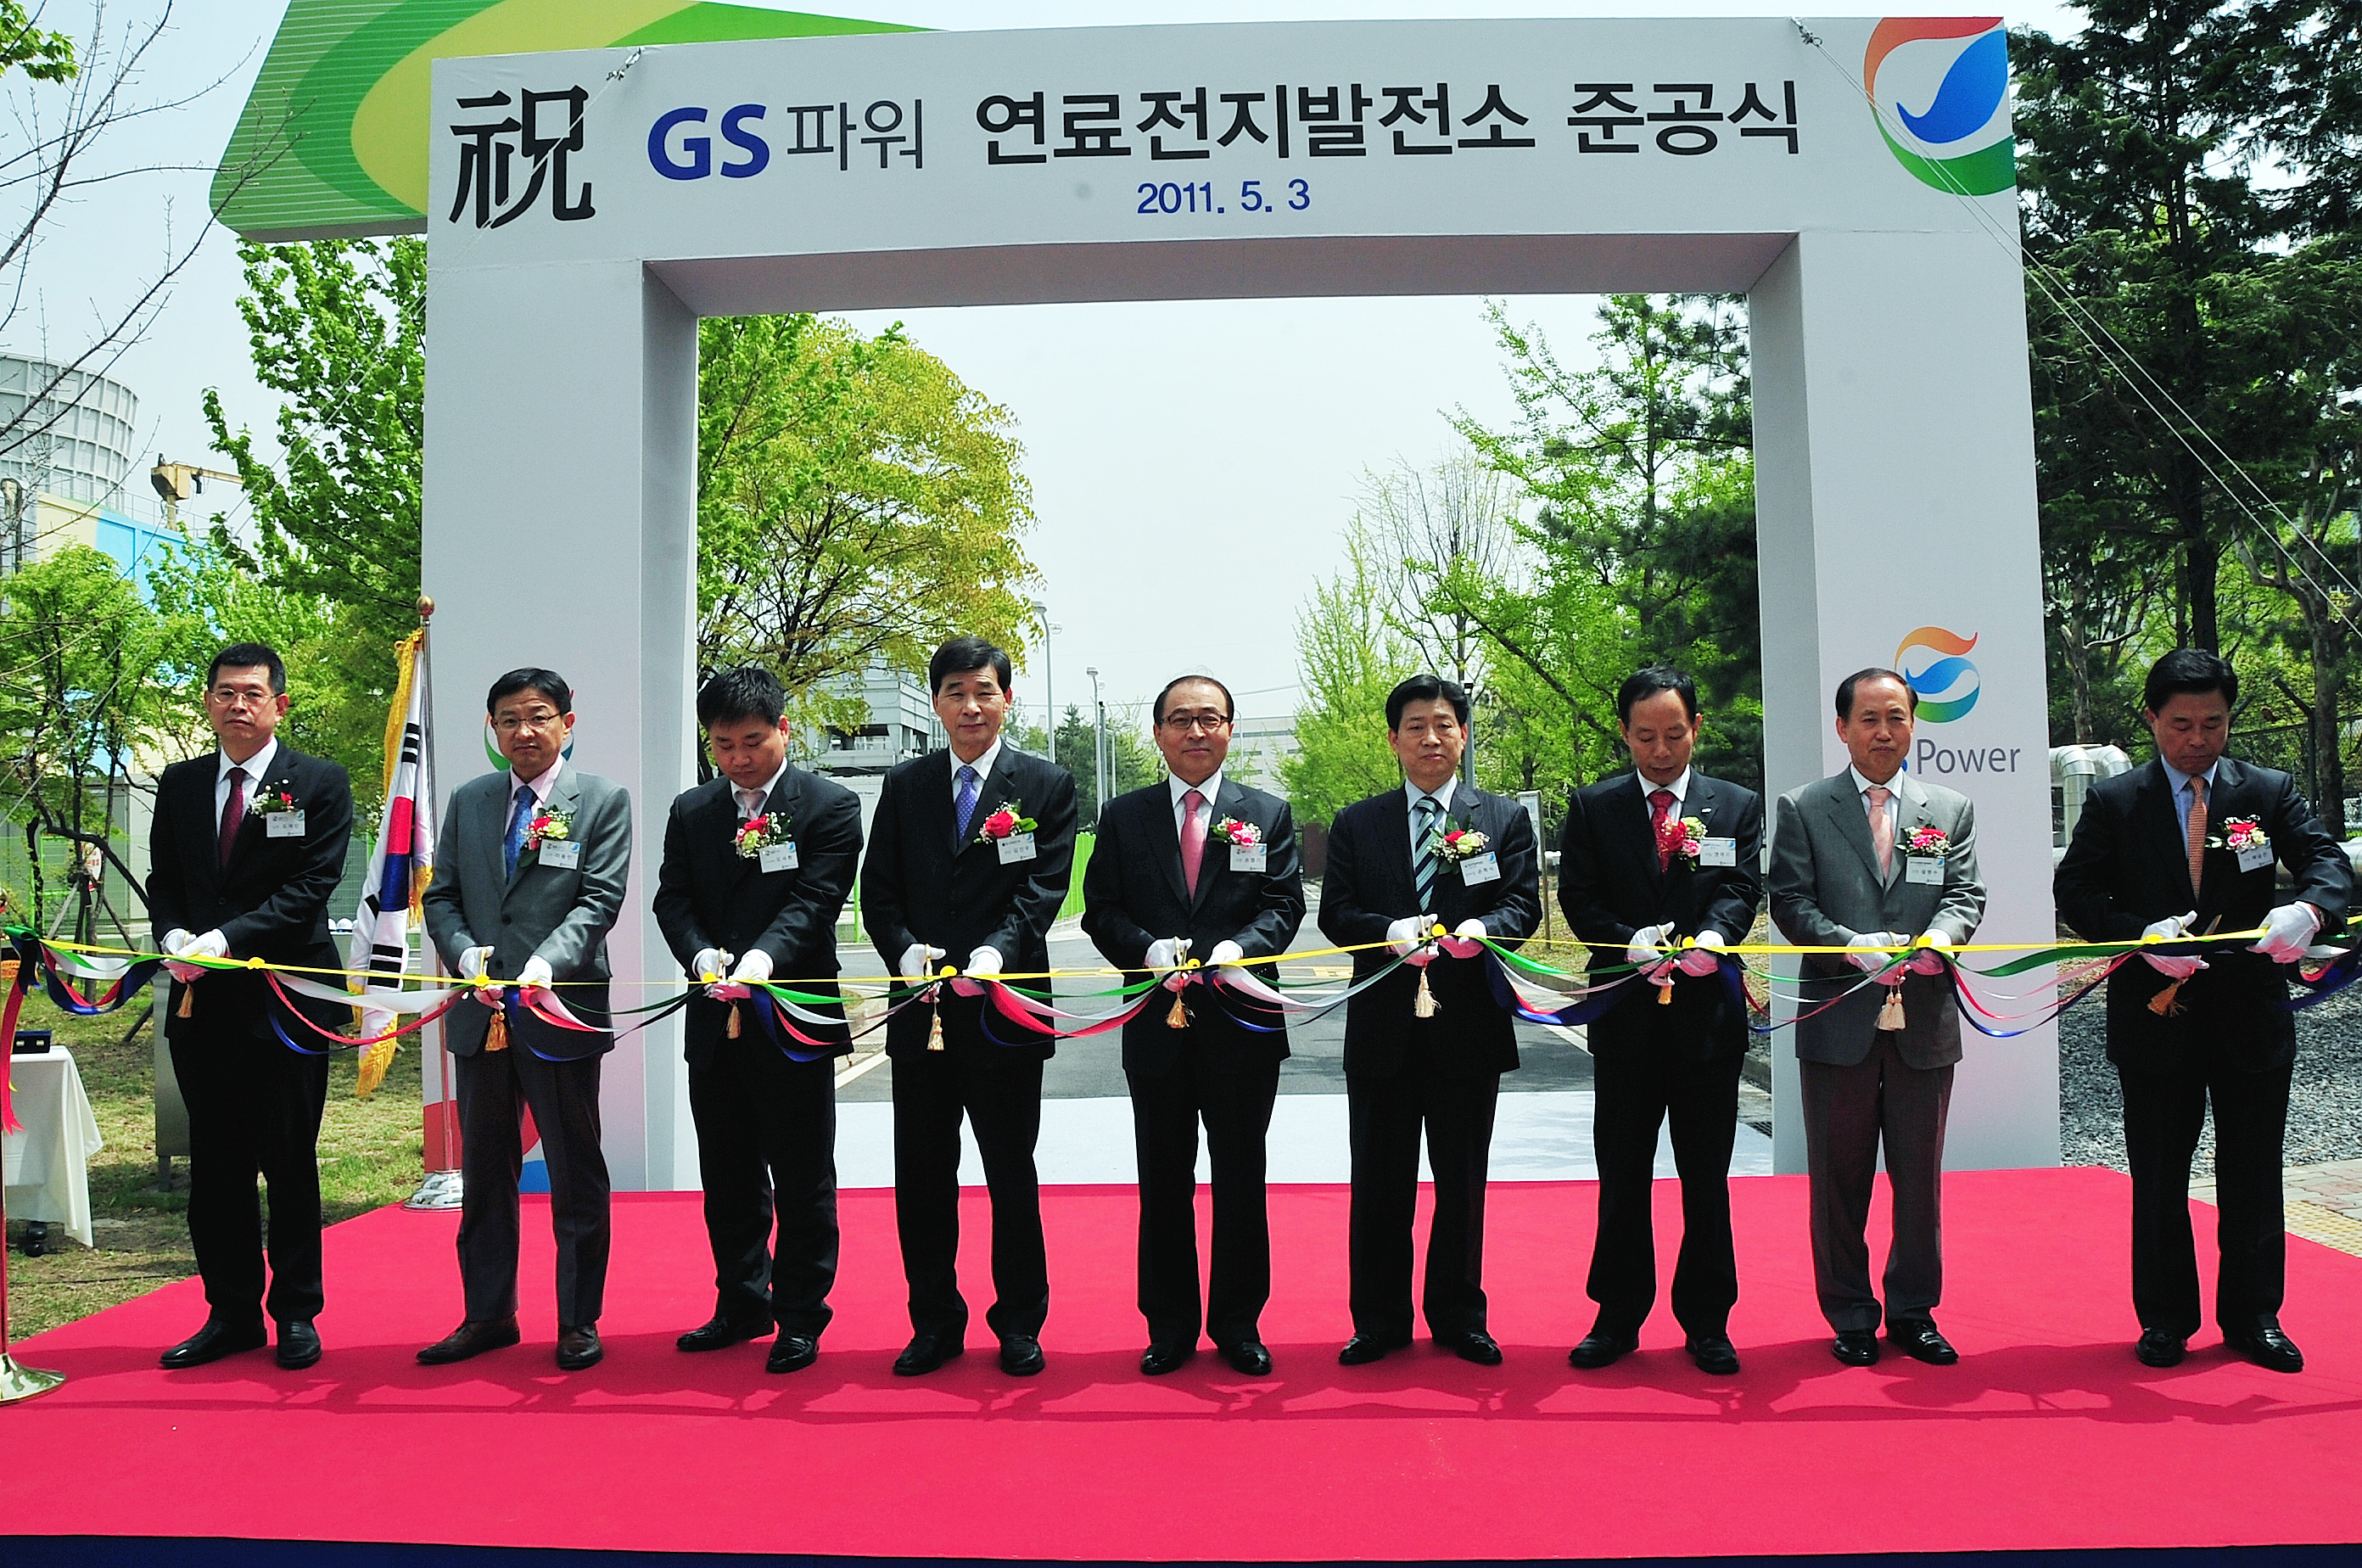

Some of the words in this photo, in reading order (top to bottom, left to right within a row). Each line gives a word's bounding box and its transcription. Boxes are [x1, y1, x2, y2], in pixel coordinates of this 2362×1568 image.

[449, 85, 596, 229] 祝
[647, 104, 770, 181] GS
[786, 98, 923, 171] 파워
[976, 82, 1536, 165] 연료전지발전소
[1566, 80, 1799, 156] 준공식
[1137, 181, 1225, 215] 2011.
[1240, 180, 1273, 213] 5.
[1288, 178, 1311, 210] 3
[1917, 738, 2021, 775] Power
